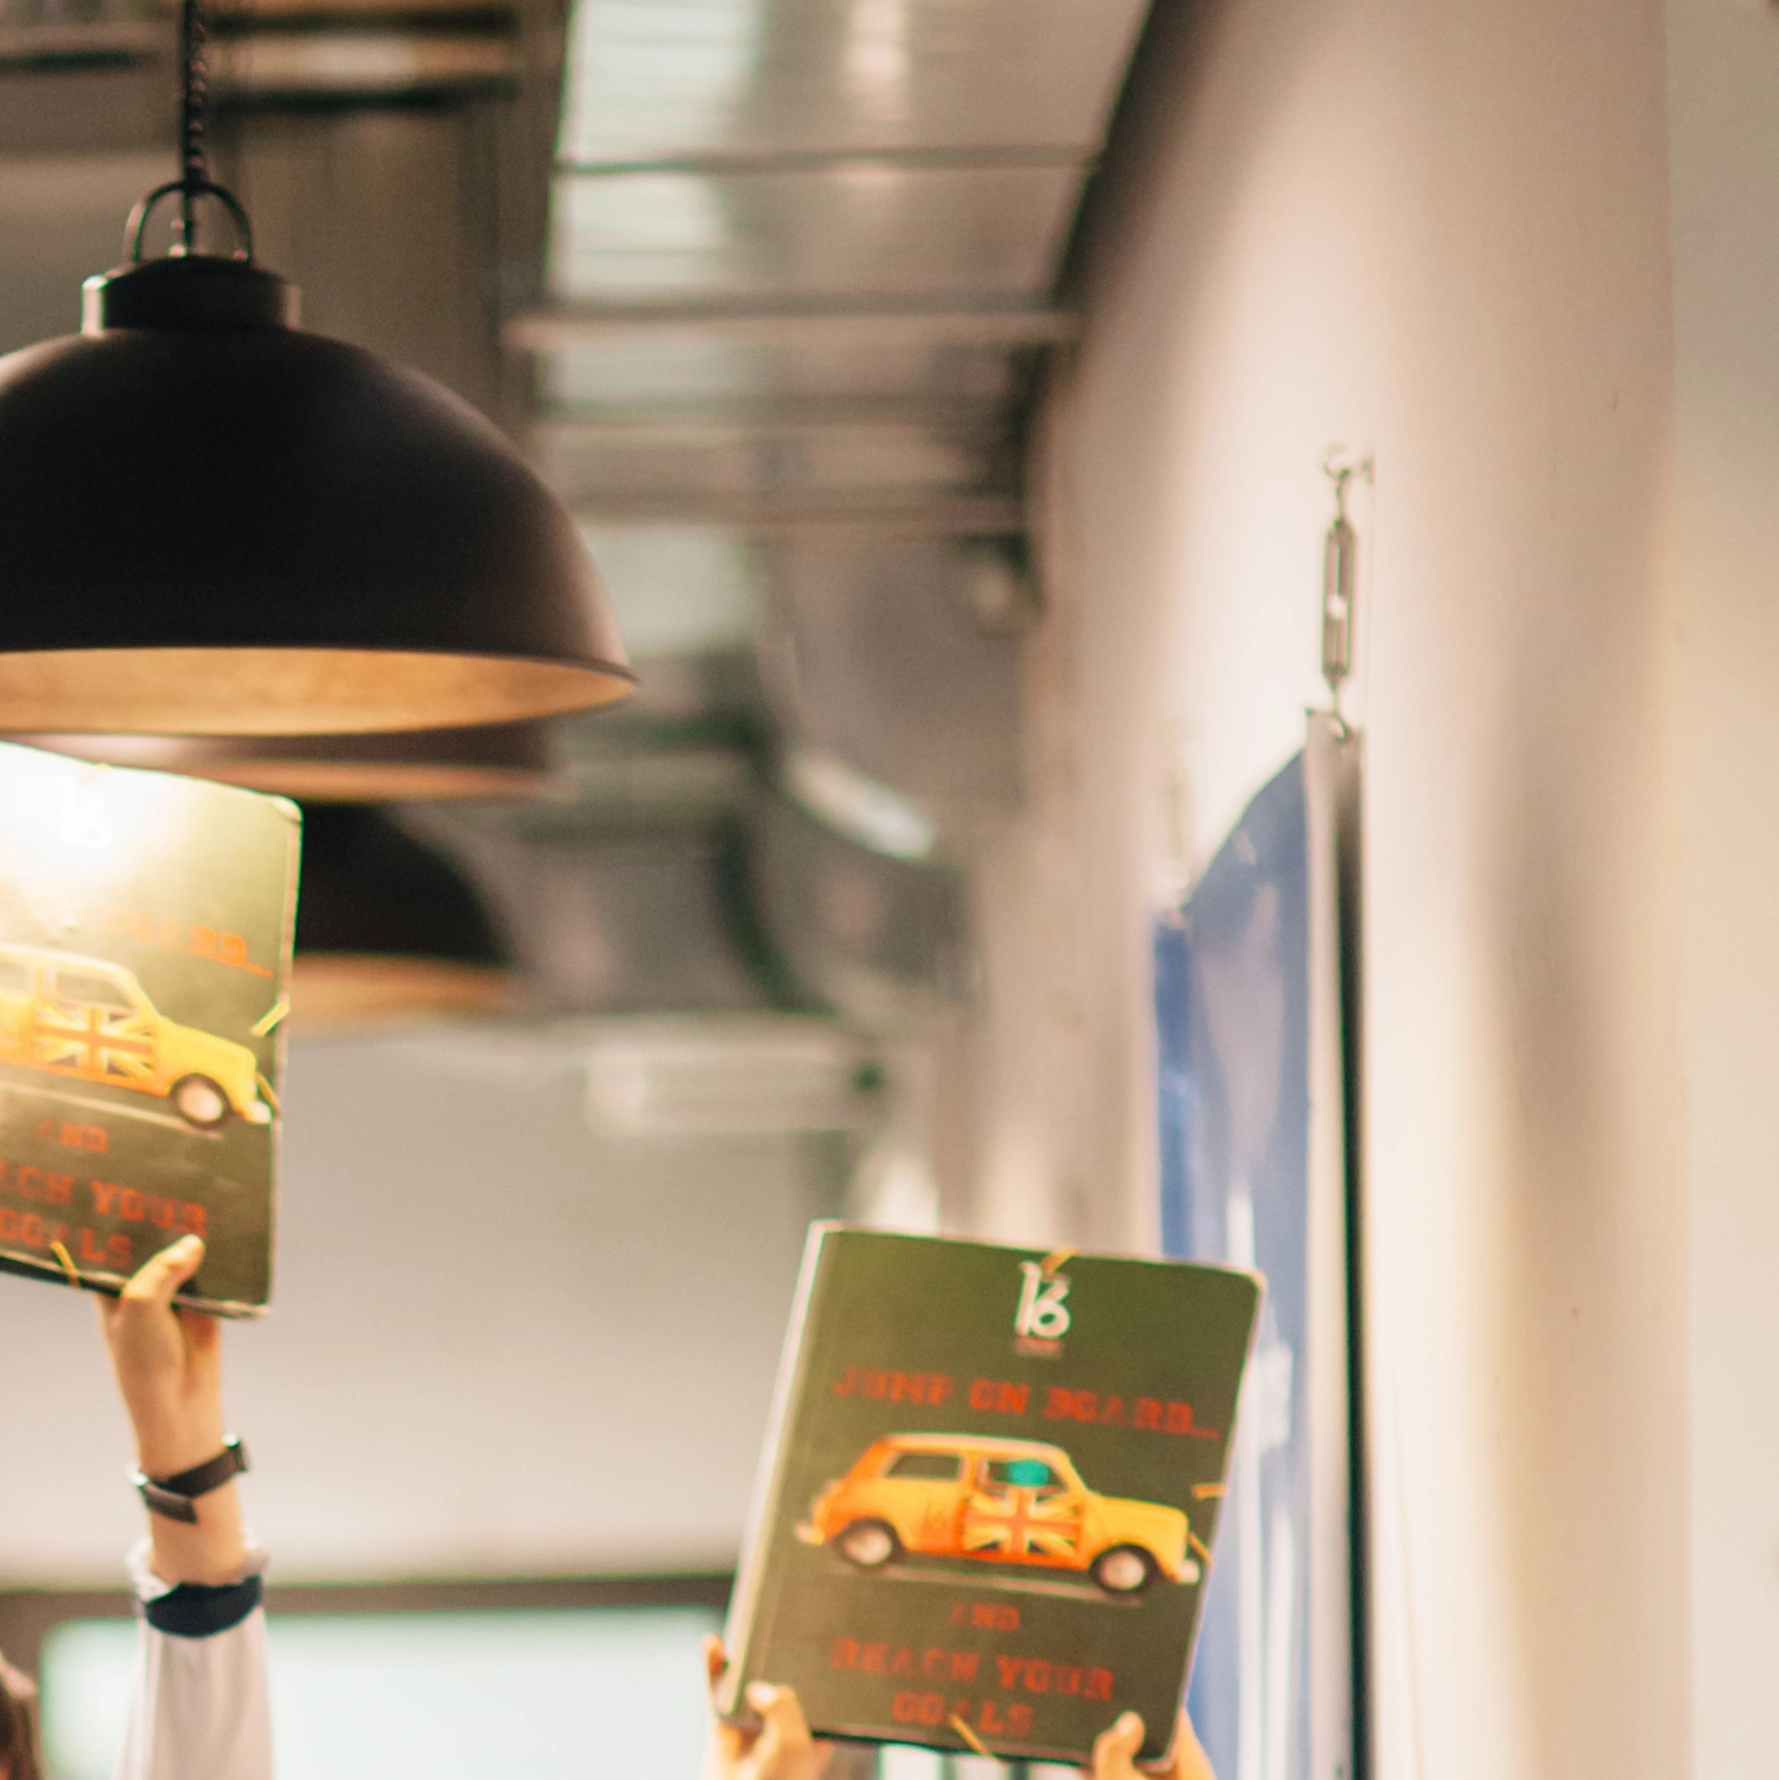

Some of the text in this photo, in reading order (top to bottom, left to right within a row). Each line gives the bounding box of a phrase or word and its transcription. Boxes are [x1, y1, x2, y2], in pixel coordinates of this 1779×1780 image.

[90, 1178, 208, 1240] YOUR
[1014, 1261, 1071, 1338] 16
[832, 1366, 954, 1407] JUMP
[968, 1378, 1029, 1415] ON
[948, 1602, 1020, 1632] AND
[830, 1637, 1115, 1701] REACH YOUR
